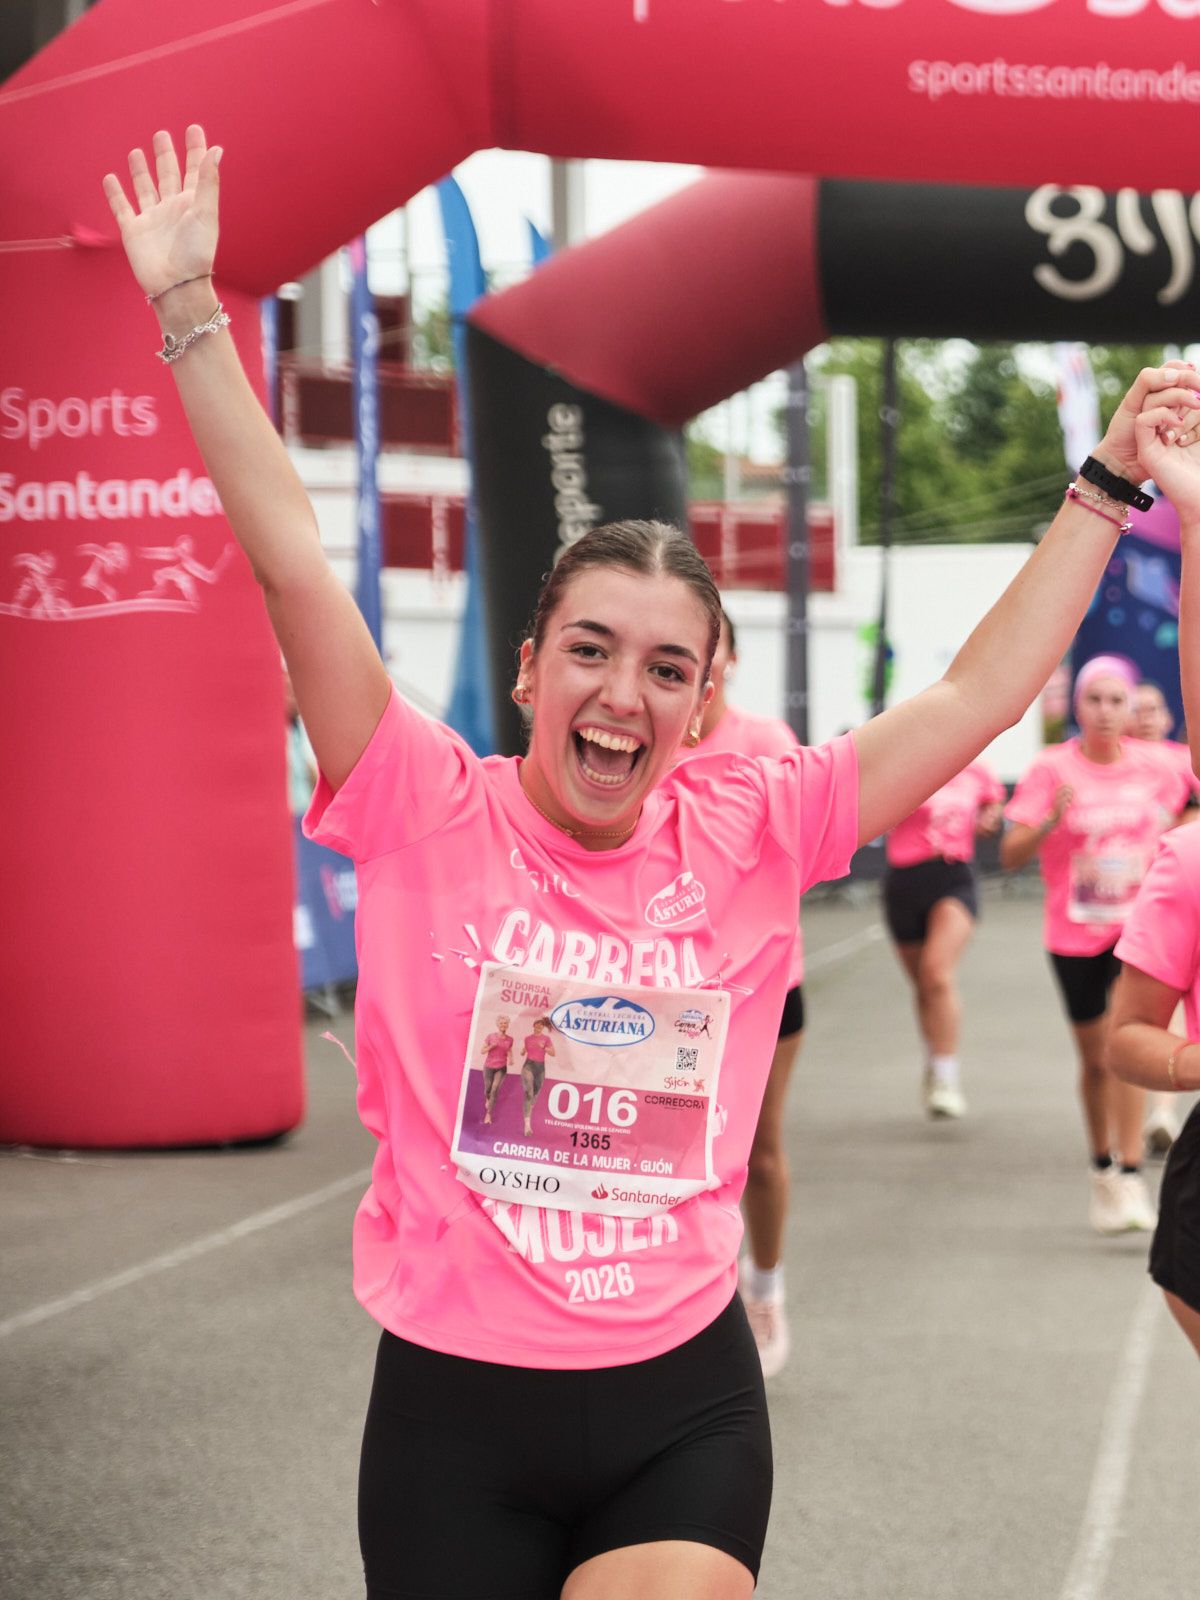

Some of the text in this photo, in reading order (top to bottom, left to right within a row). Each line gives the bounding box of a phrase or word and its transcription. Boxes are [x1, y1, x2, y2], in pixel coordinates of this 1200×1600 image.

[0, 386, 158, 450] Sports
[493, 909, 705, 989] CARRERA
[500, 989, 550, 1009] SUMA
[501, 979, 552, 996] TU DORSAL
[559, 1009, 646, 1036] ASTURIANA
[547, 1082, 638, 1128] 016
[644, 1095, 705, 1110] CORREDORA
[569, 1131, 611, 1151] 1365
[493, 1141, 550, 1163] CARRERA
[553, 1153, 570, 1165] DE
[573, 1154, 589, 1168] LA
[592, 1157, 631, 1172] MUJER
[640, 1158, 674, 1175] GIJÓN
[479, 1167, 561, 1194] OYSHO
[611, 1188, 682, 1206] Santander
[565, 1261, 635, 1304] 2026
